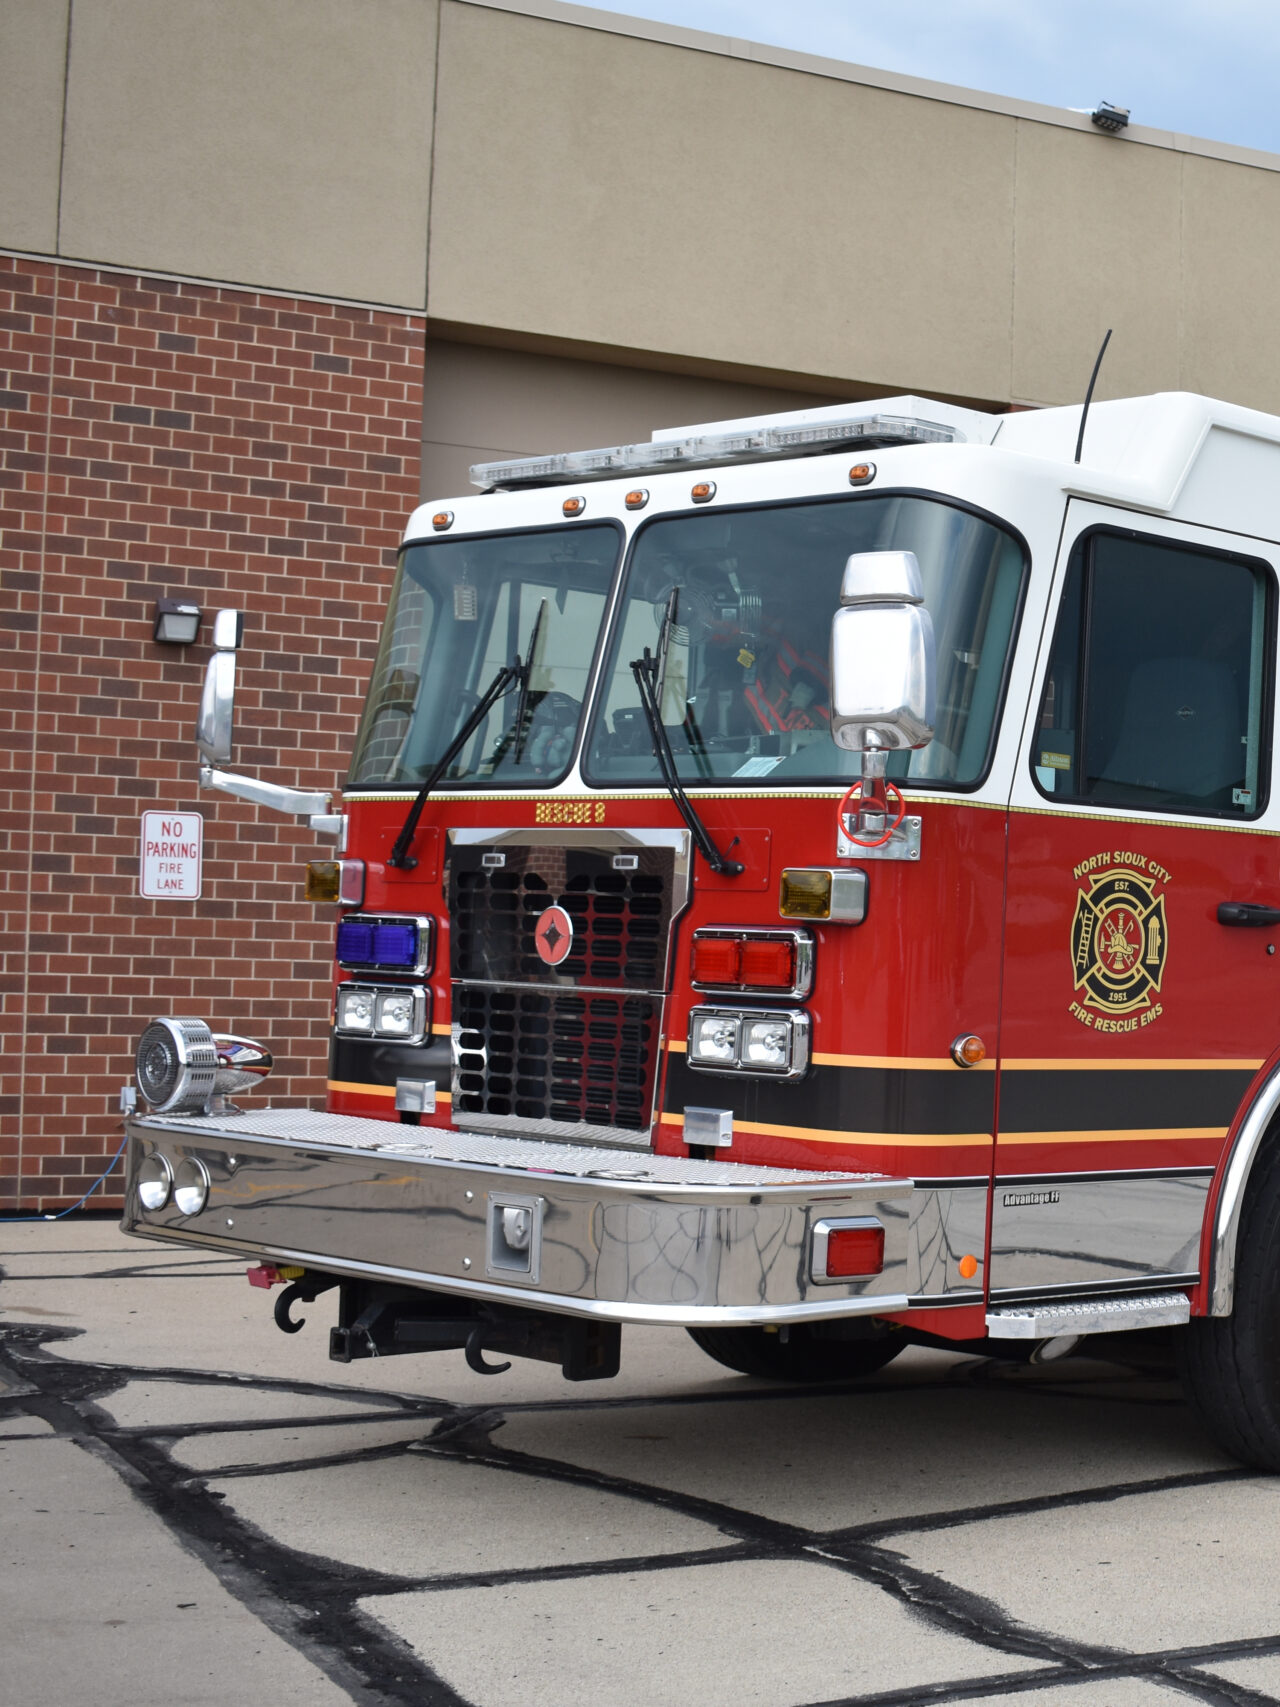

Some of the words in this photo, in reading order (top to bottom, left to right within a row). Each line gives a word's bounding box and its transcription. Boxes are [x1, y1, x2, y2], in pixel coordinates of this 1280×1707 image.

[535, 802, 592, 824] RESCUE
[594, 802, 606, 824] 8
[161, 821, 183, 838] NO
[146, 841, 197, 859] PARKING
[158, 862, 184, 874] FIRE
[1073, 851, 1111, 880] NORTH
[1113, 851, 1148, 869] SIOUX
[1148, 860, 1172, 884] CITY
[157, 878, 184, 890] LANE
[1114, 881, 1130, 891] EST.
[1108, 991, 1128, 1002] 1951
[1068, 1000, 1094, 1026] FIRE
[1094, 1017, 1138, 1033] RESCUE
[1140, 1002, 1163, 1027] EMS
[1003, 1192, 1050, 1207] Advantage
